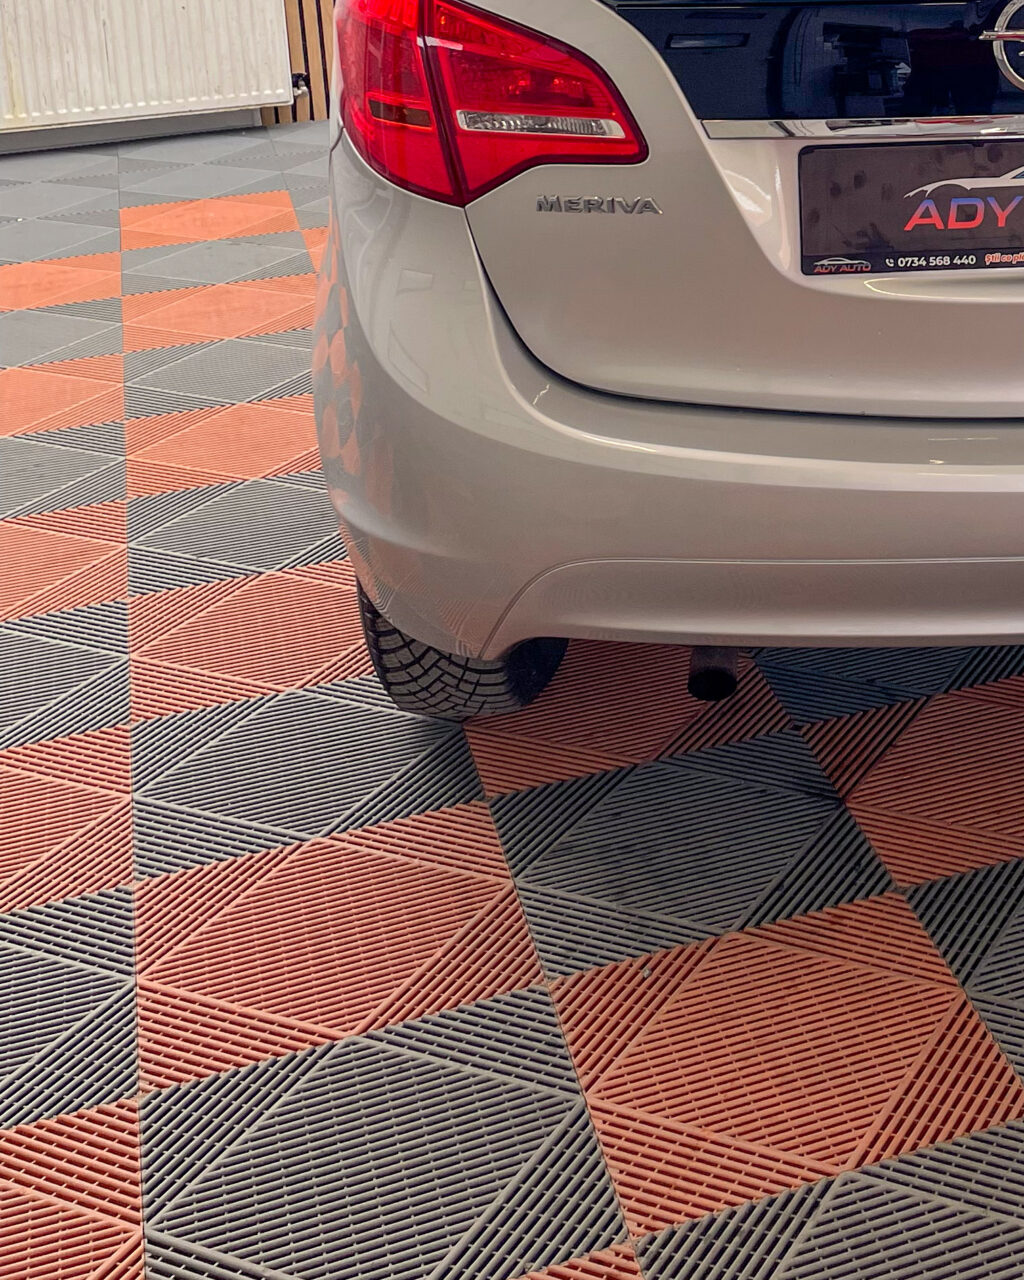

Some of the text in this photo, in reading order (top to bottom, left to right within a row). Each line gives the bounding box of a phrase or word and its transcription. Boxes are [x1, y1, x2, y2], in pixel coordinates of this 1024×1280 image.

[536, 195, 663, 214] MERIVA
[903, 195, 1024, 231] ADY
[813, 263, 871, 273] ADY AUTO
[897, 255, 977, 268] 0734 568 440
